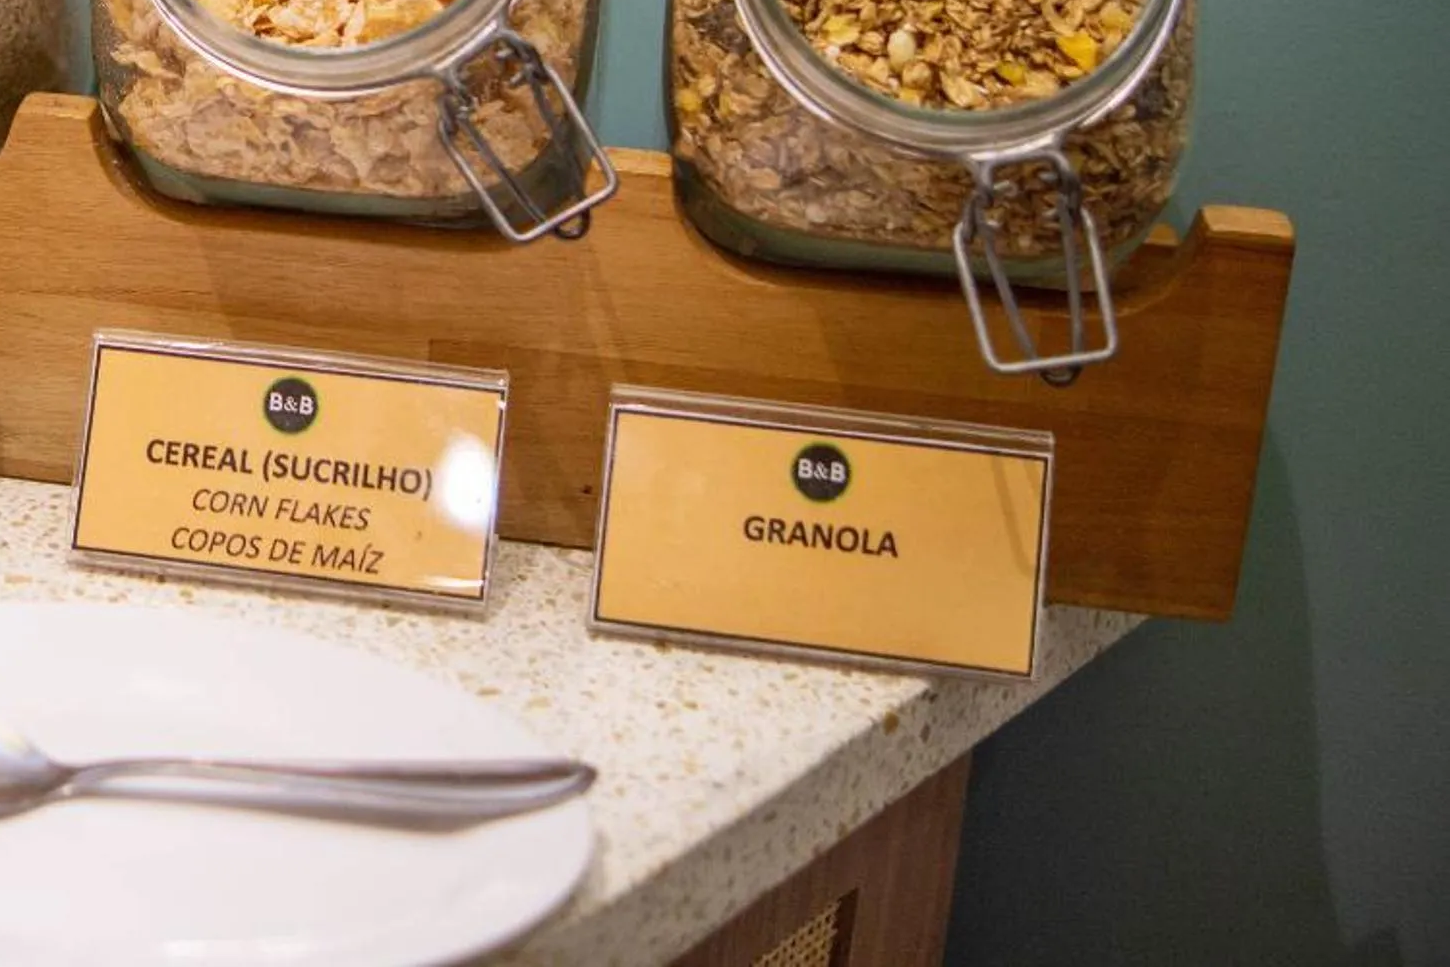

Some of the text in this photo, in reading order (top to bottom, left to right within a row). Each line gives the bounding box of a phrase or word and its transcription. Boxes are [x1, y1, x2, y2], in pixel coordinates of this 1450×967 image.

[268, 391, 315, 416] B&B
[146, 438, 433, 502] CEREAL (SUCRILHO)
[798, 458, 846, 484] B&B
[192, 488, 372, 532] CORN FLAKES
[171, 526, 385, 575] COPOS DE MAÍZ
[743, 515, 899, 559] GRANOLA
